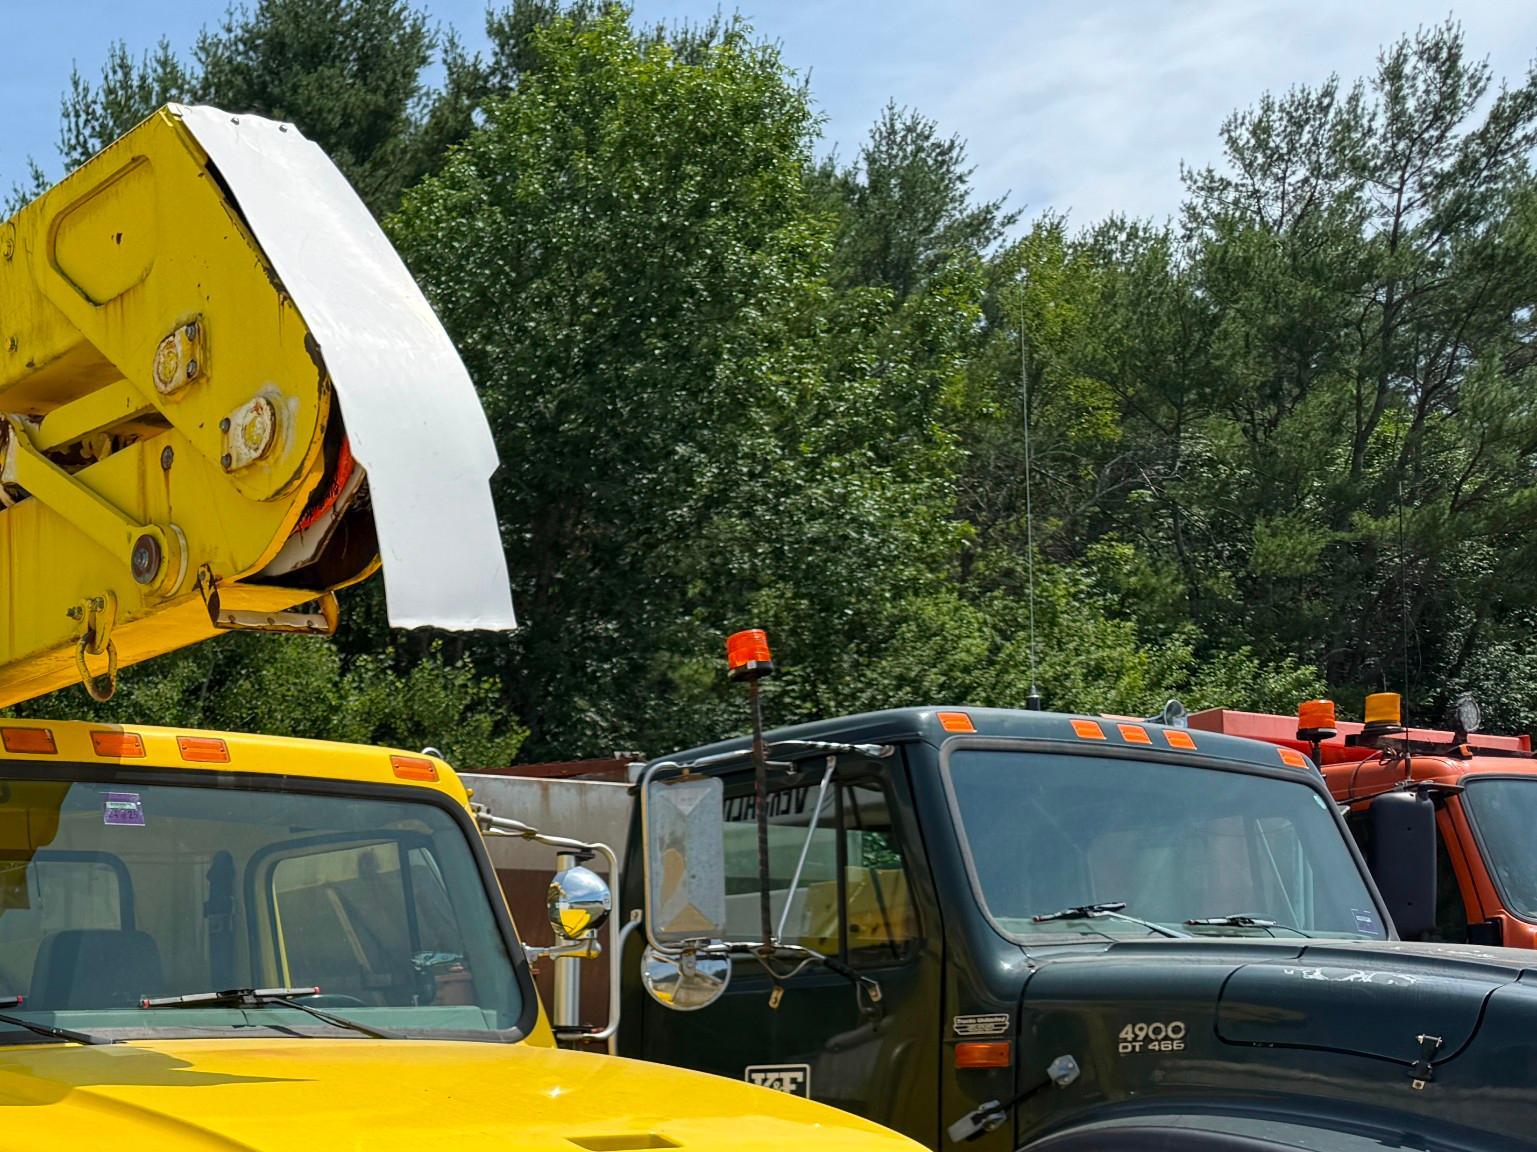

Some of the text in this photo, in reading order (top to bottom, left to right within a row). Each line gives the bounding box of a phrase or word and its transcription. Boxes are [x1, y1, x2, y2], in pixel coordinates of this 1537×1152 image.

[1118, 1021, 1185, 1041] 4900
[1118, 1040, 1185, 1053] DT 466
